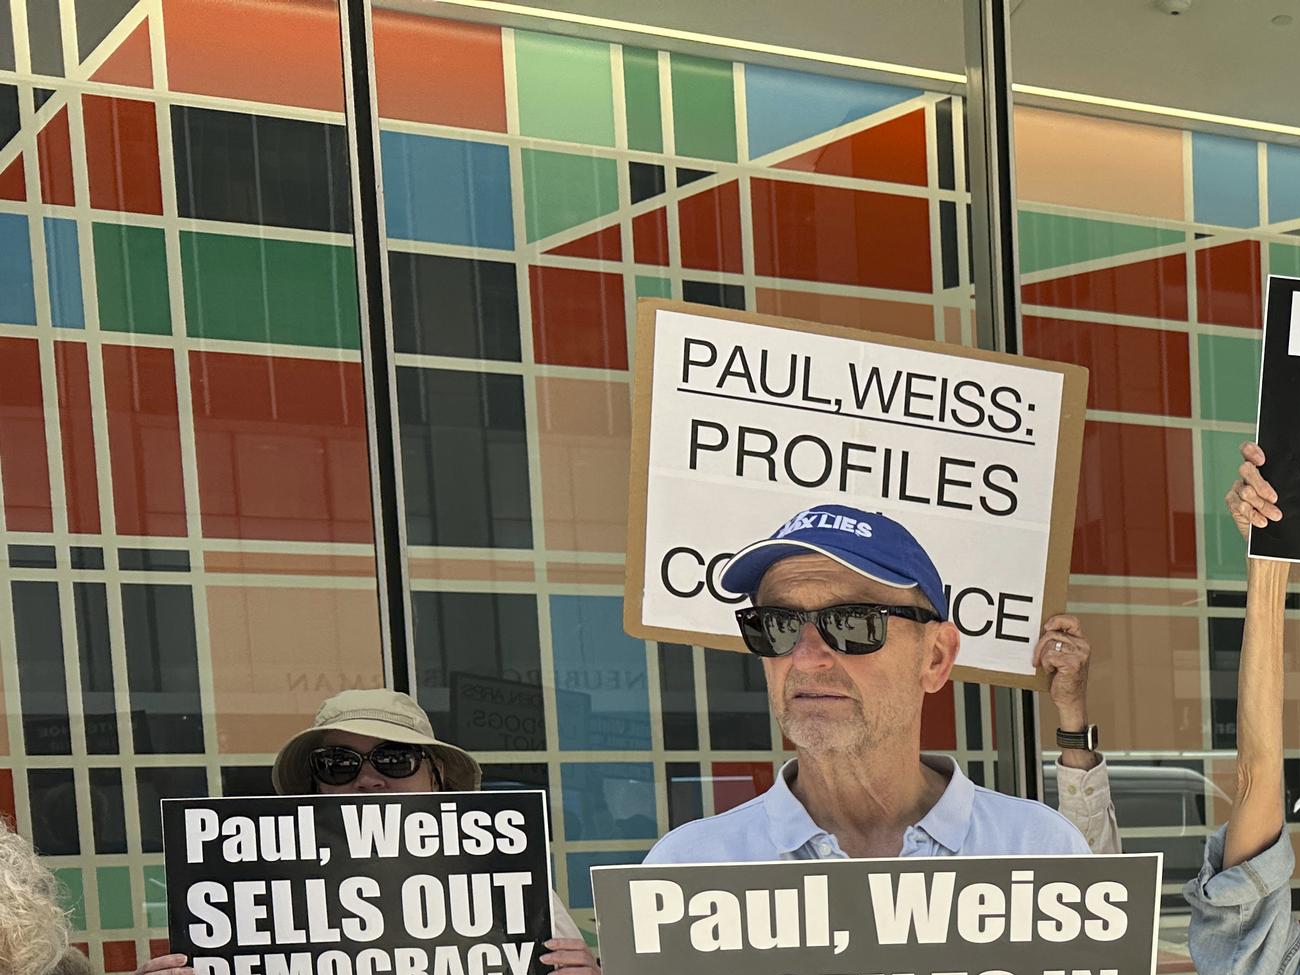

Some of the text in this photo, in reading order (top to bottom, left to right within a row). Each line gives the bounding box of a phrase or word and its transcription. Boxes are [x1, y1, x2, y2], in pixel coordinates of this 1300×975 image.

[690, 418, 1018, 516] PROFILES
[818, 514, 872, 538] LIES
[660, 546, 1034, 644] COICE
[184, 802, 527, 866] Paul, Weiss
[186, 872, 532, 949] SELLS OUT
[629, 870, 1128, 955] Paul, Weiss
